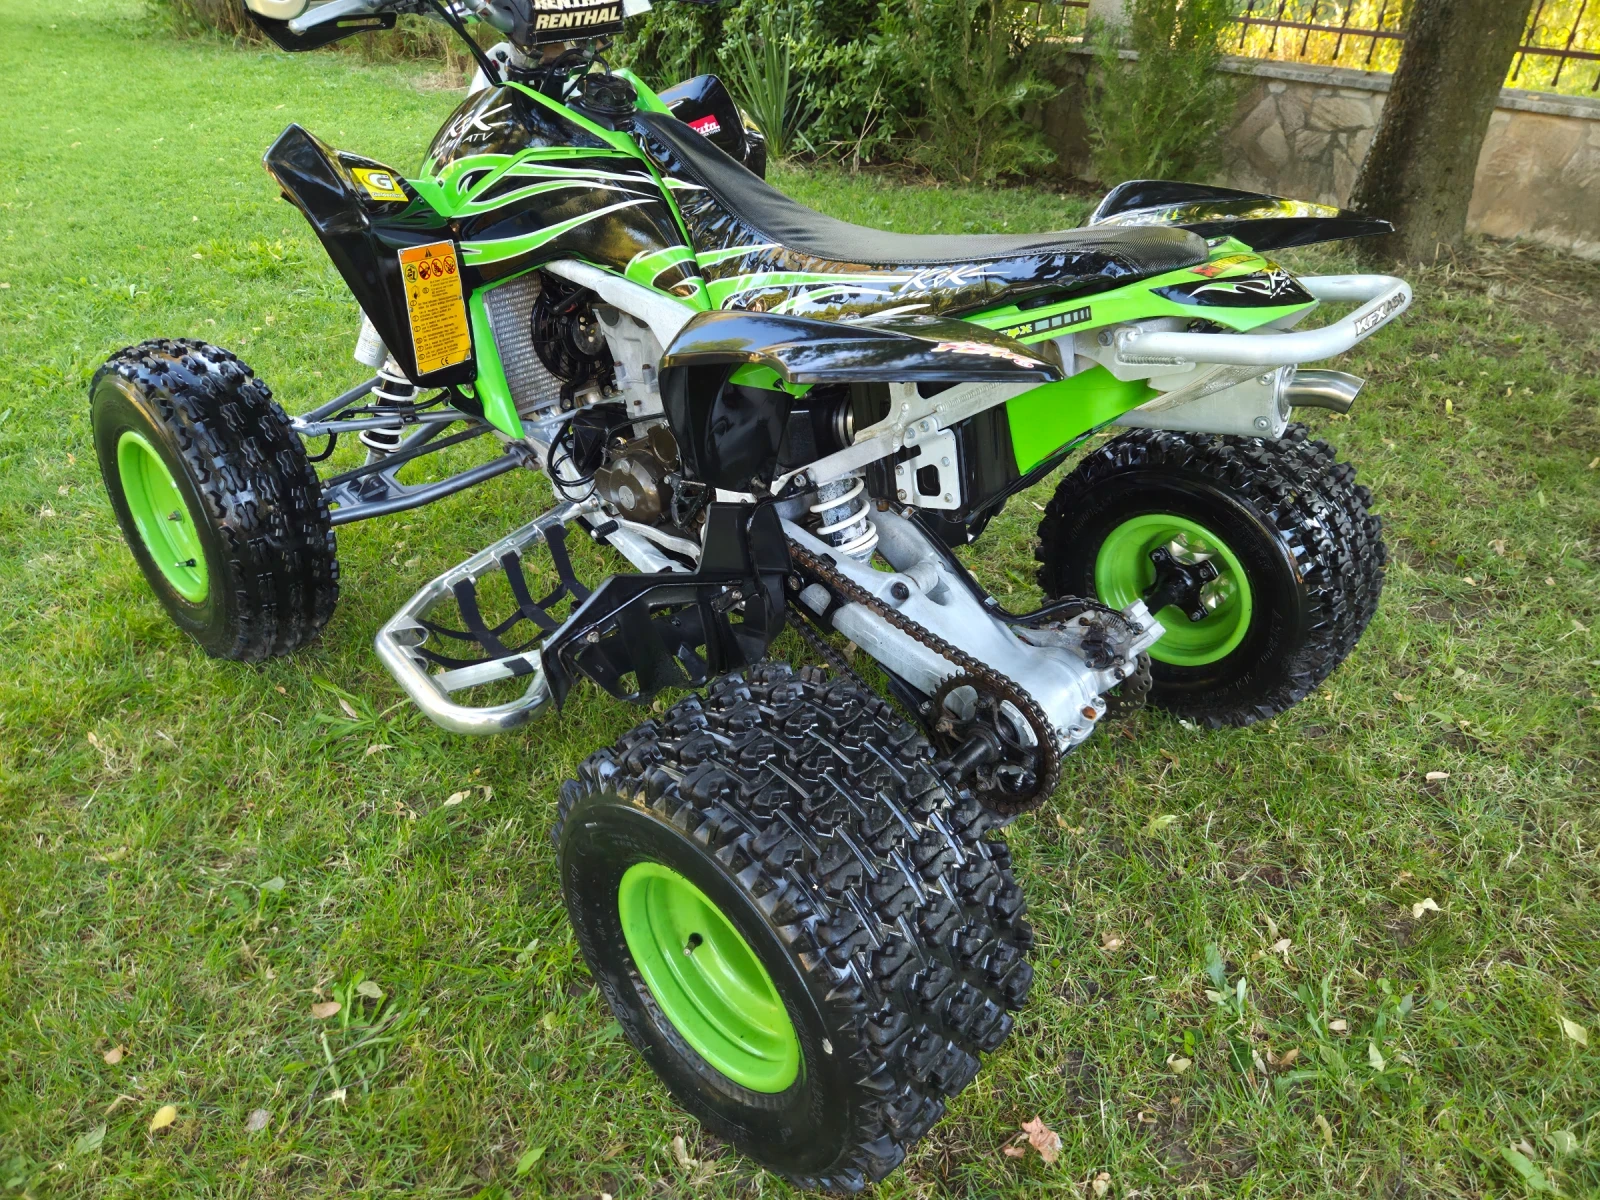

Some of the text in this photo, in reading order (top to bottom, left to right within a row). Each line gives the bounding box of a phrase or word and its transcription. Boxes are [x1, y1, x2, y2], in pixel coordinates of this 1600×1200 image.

[535, 6, 620, 30] RENTHAL
[461, 131, 495, 144] ATV
[1355, 305, 1387, 336] KFX
